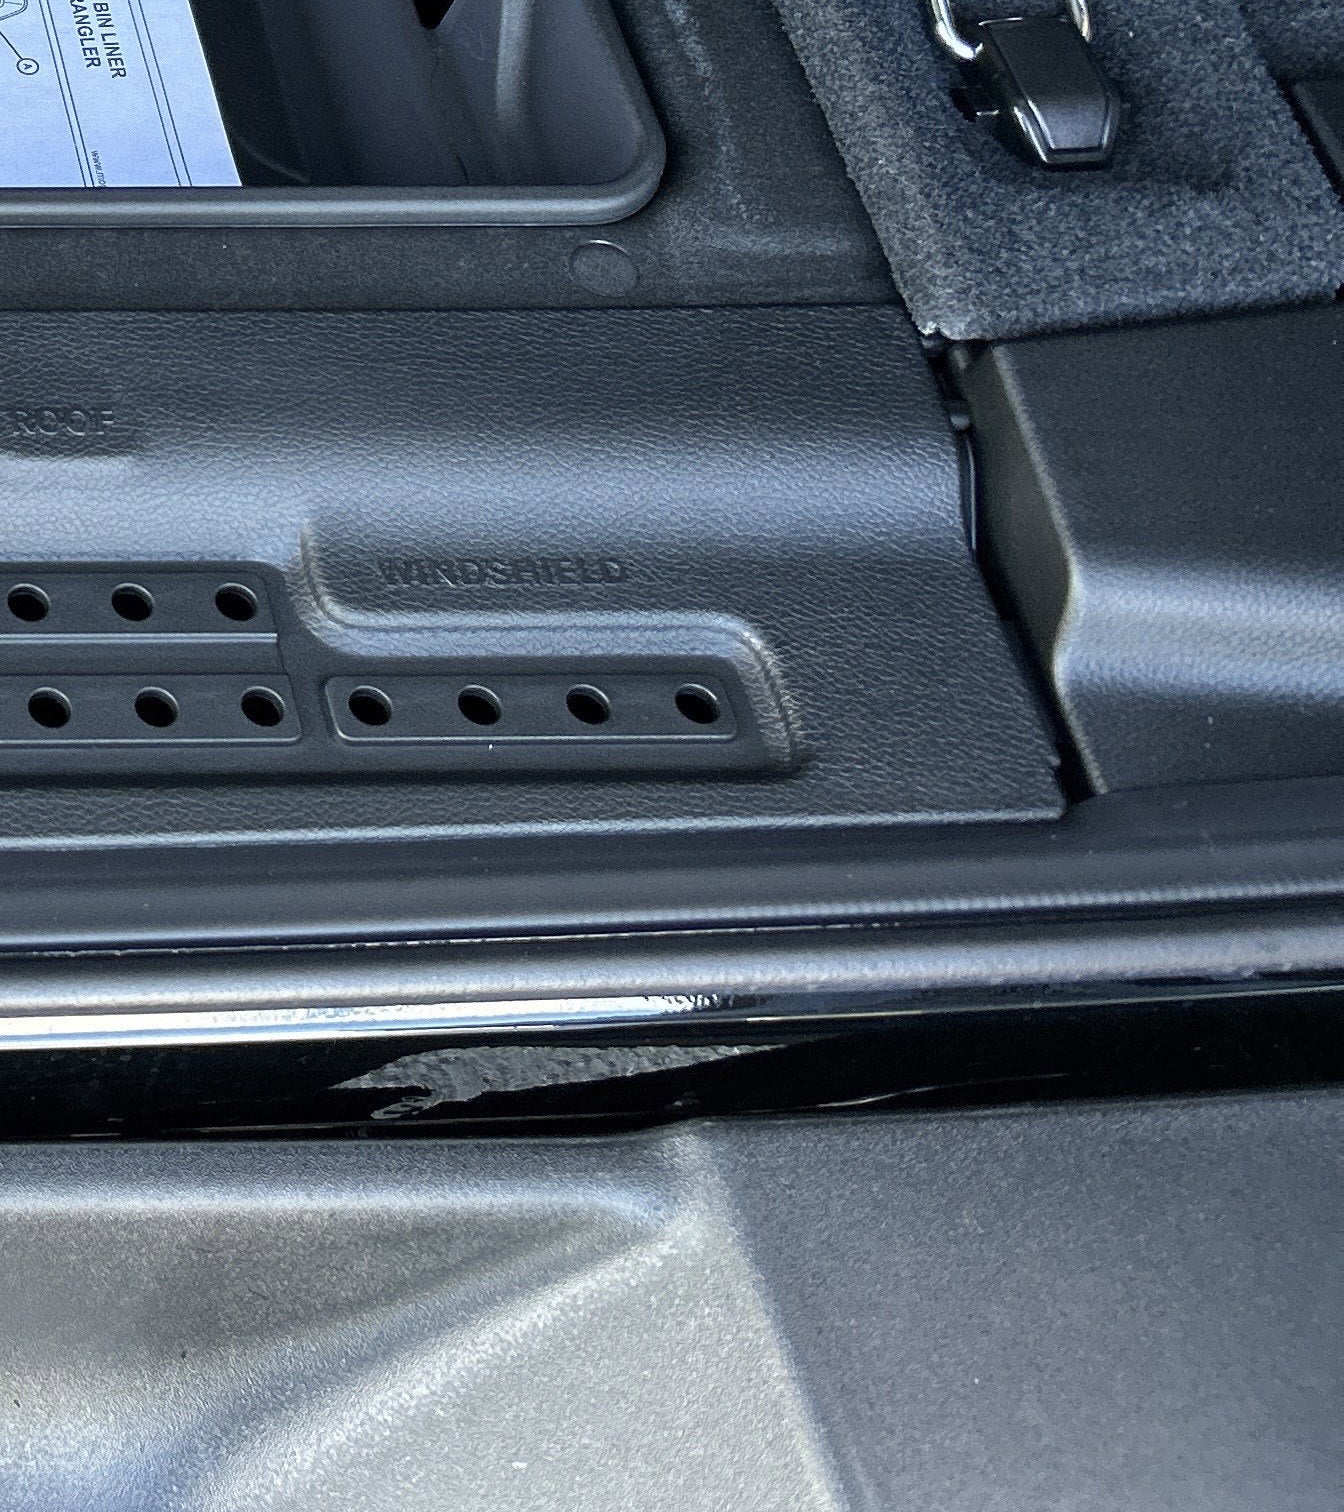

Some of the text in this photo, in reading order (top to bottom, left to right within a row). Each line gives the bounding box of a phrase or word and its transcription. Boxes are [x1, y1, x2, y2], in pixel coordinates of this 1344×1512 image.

[92, 2, 113, 29] BIN
[101, 32, 127, 79] LINER
[11, 405, 115, 436] ROOF
[376, 556, 629, 588] WINDSHIELD
